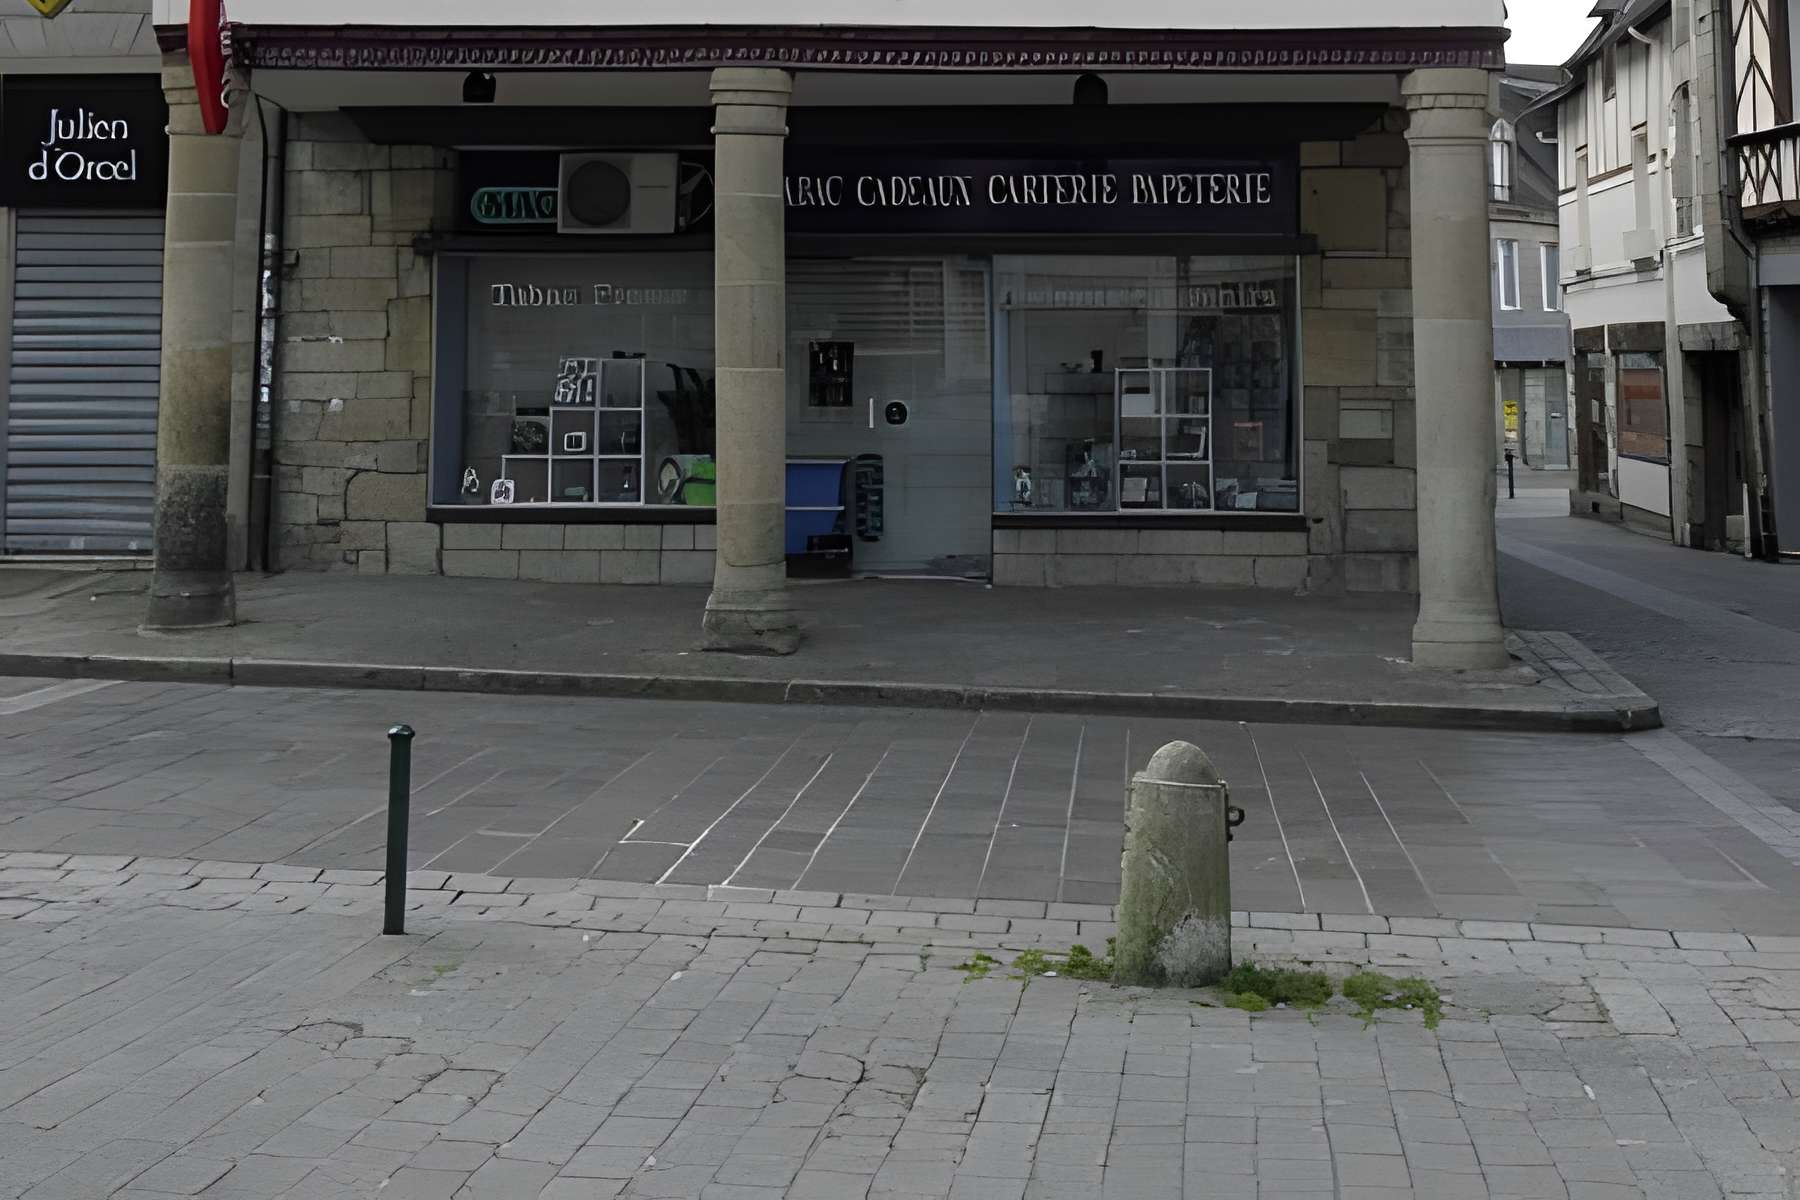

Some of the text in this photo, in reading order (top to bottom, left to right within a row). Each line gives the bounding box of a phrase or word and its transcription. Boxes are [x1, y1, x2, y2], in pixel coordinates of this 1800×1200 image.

[40, 107, 129, 146] Julien
[28, 147, 137, 181] d'Orcel
[784, 173, 1271, 206] ABAC CADEAUX CARTERIE PAPETERIE
